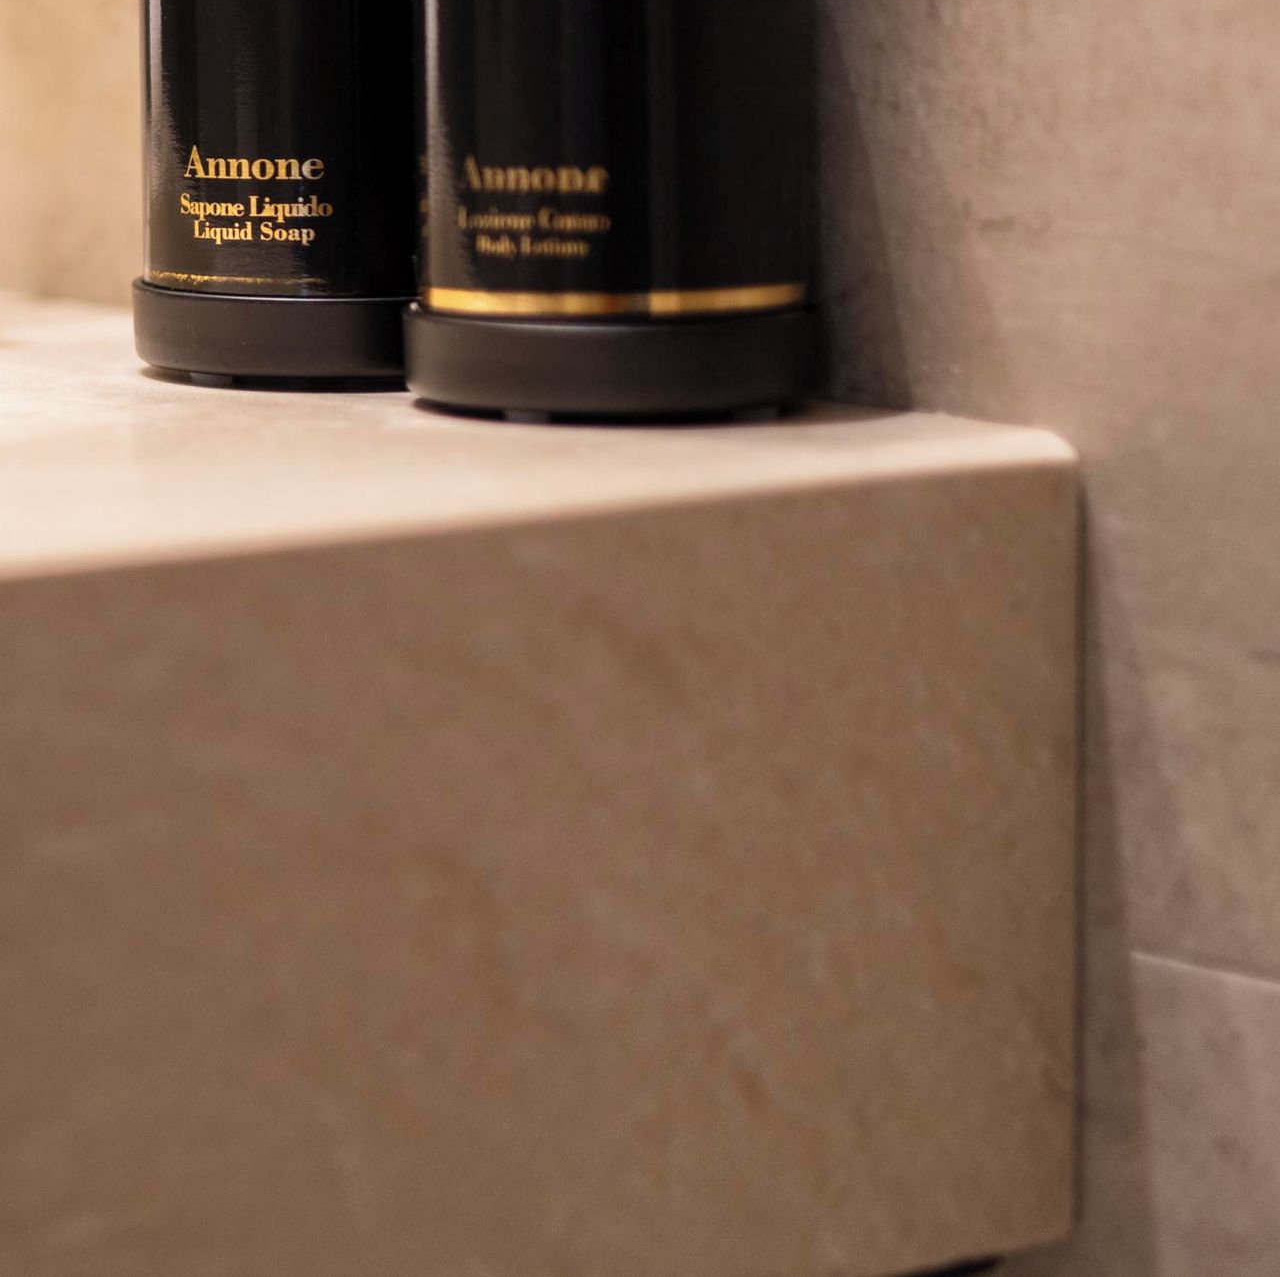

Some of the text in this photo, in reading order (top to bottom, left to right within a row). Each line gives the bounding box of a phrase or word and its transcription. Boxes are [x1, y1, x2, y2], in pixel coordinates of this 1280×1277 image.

[184, 144, 326, 181] Annone
[180, 193, 334, 223] Sapone Liquido
[193, 220, 316, 246] Liquid Soap
